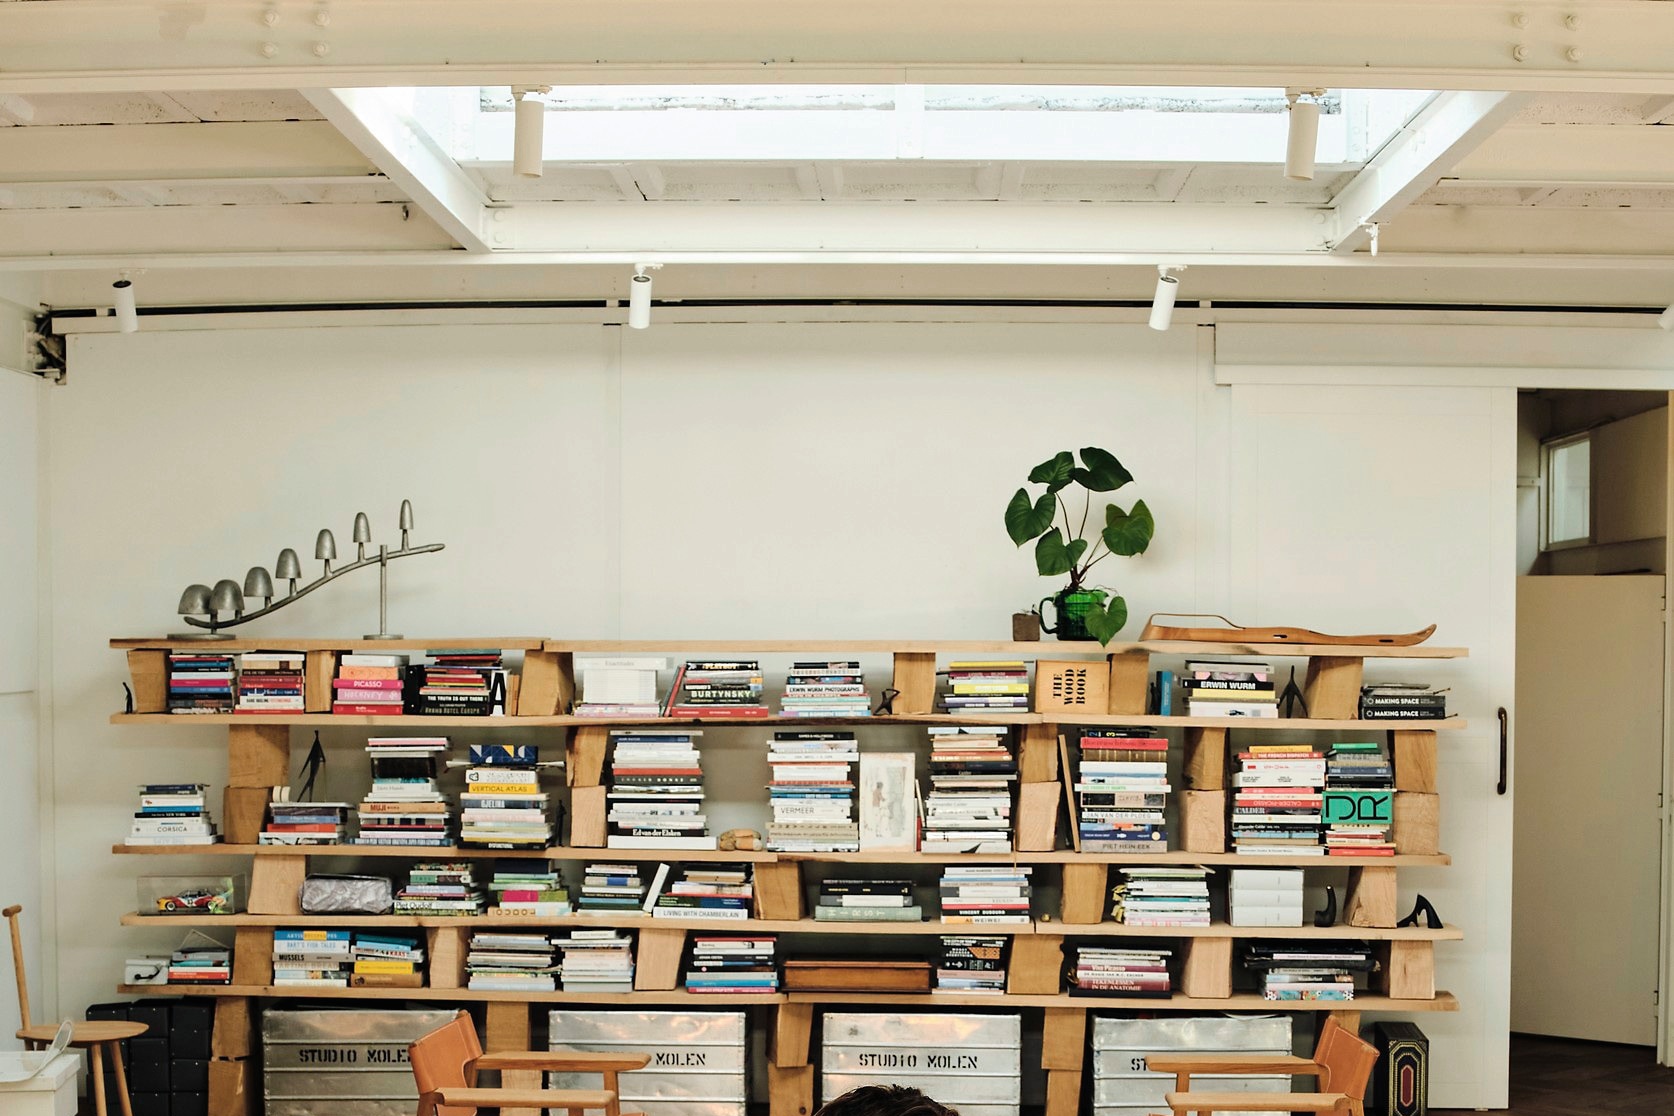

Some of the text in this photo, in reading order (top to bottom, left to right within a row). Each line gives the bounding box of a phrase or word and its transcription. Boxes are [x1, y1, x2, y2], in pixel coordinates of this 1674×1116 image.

[353, 680, 383, 688] PICASSO
[1052, 673, 1063, 699] THE
[1063, 668, 1075, 705] WOOD
[1075, 668, 1087, 705] BOOK
[1200, 681, 1256, 690] ERWIN WURM
[344, 691, 383, 699] HOCKNEY
[491, 671, 507, 716] A
[827, 909, 885, 917] HIRST
[299, 1049, 358, 1063] STUDIO
[655, 1052, 706, 1066] MOLEN
[859, 1053, 978, 1069] STUDIO MOLEN
